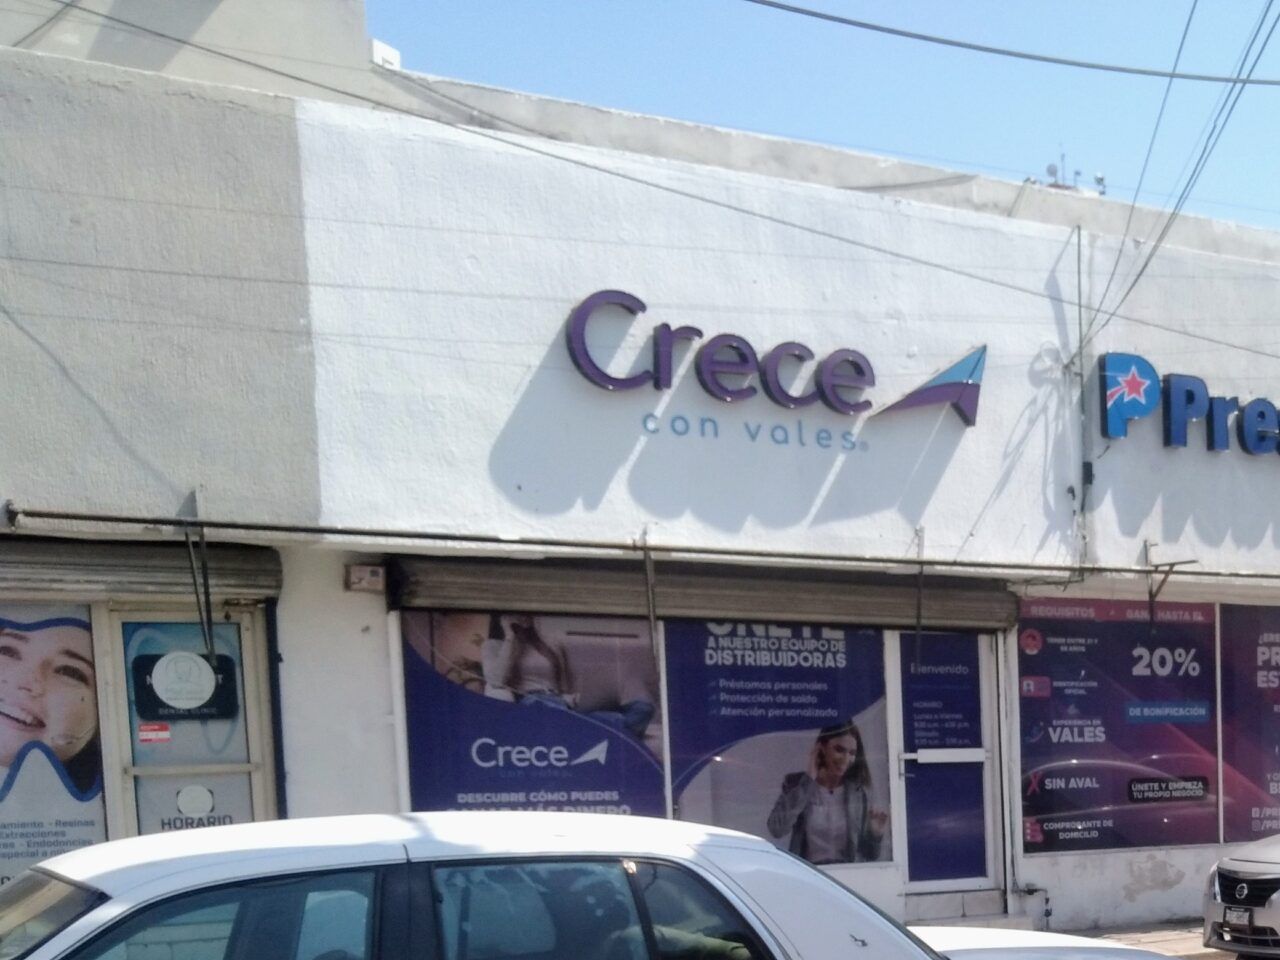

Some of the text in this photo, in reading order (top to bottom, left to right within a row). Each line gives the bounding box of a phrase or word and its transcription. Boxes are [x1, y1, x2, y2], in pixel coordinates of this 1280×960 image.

[566, 289, 876, 416] Crece
[641, 413, 857, 451] con vales
[1030, 606, 1095, 618] REQUISITOS
[1156, 610, 1190, 621] HASTA
[707, 636, 846, 652] A NUESTRO EQUIPO DE
[705, 650, 847, 668] DISTRIBUIDORAS
[1131, 648, 1200, 676] 20%
[774, 681, 828, 691] personales
[720, 692, 773, 703] Protección
[720, 707, 766, 716] Atención
[1129, 706, 1206, 716] DE BONIFICACIÓN
[1048, 726, 1106, 743] VALES
[471, 738, 569, 767] Crece
[1045, 777, 1100, 789] SIN AVAL
[1161, 782, 1167, 790] Y
[1168, 781, 1203, 790] EMPIEZA
[457, 790, 619, 803] DESCUBRE CÓMO PUEDES
[1144, 790, 1170, 798] PROPIO
[1172, 789, 1204, 797] NEGOCIO
[161, 814, 233, 830] HORARIO
[1043, 821, 1102, 830] COMPROBANTE
[1059, 830, 1098, 839] DOMICILIO
